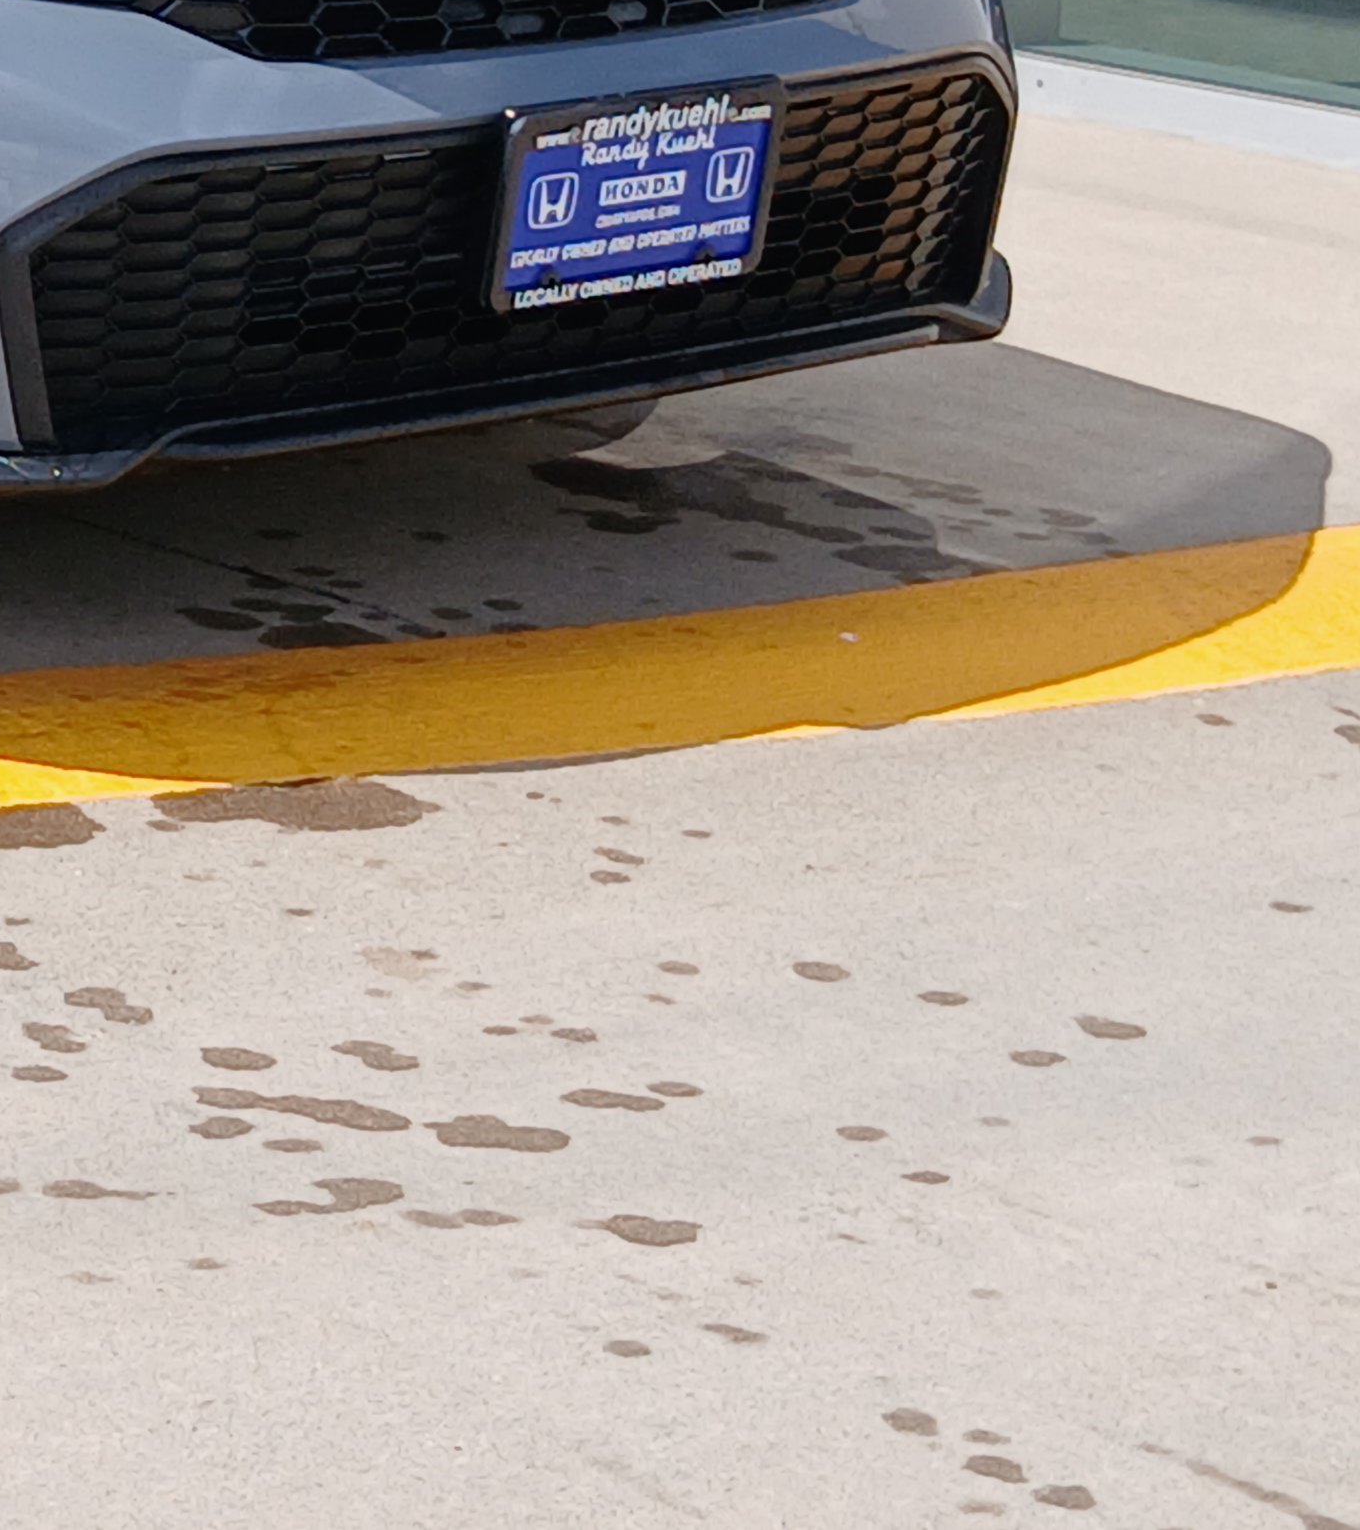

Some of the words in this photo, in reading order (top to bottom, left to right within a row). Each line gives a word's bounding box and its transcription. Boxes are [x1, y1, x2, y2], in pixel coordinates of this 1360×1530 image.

[580, 140, 650, 170] Randy
[656, 126, 716, 157] Kuehl
[603, 174, 680, 201] HONDA
[514, 282, 579, 310] LOCALLY
[580, 275, 634, 300] OWNED
[634, 270, 666, 290] AND
[668, 258, 742, 286] OPERATED
